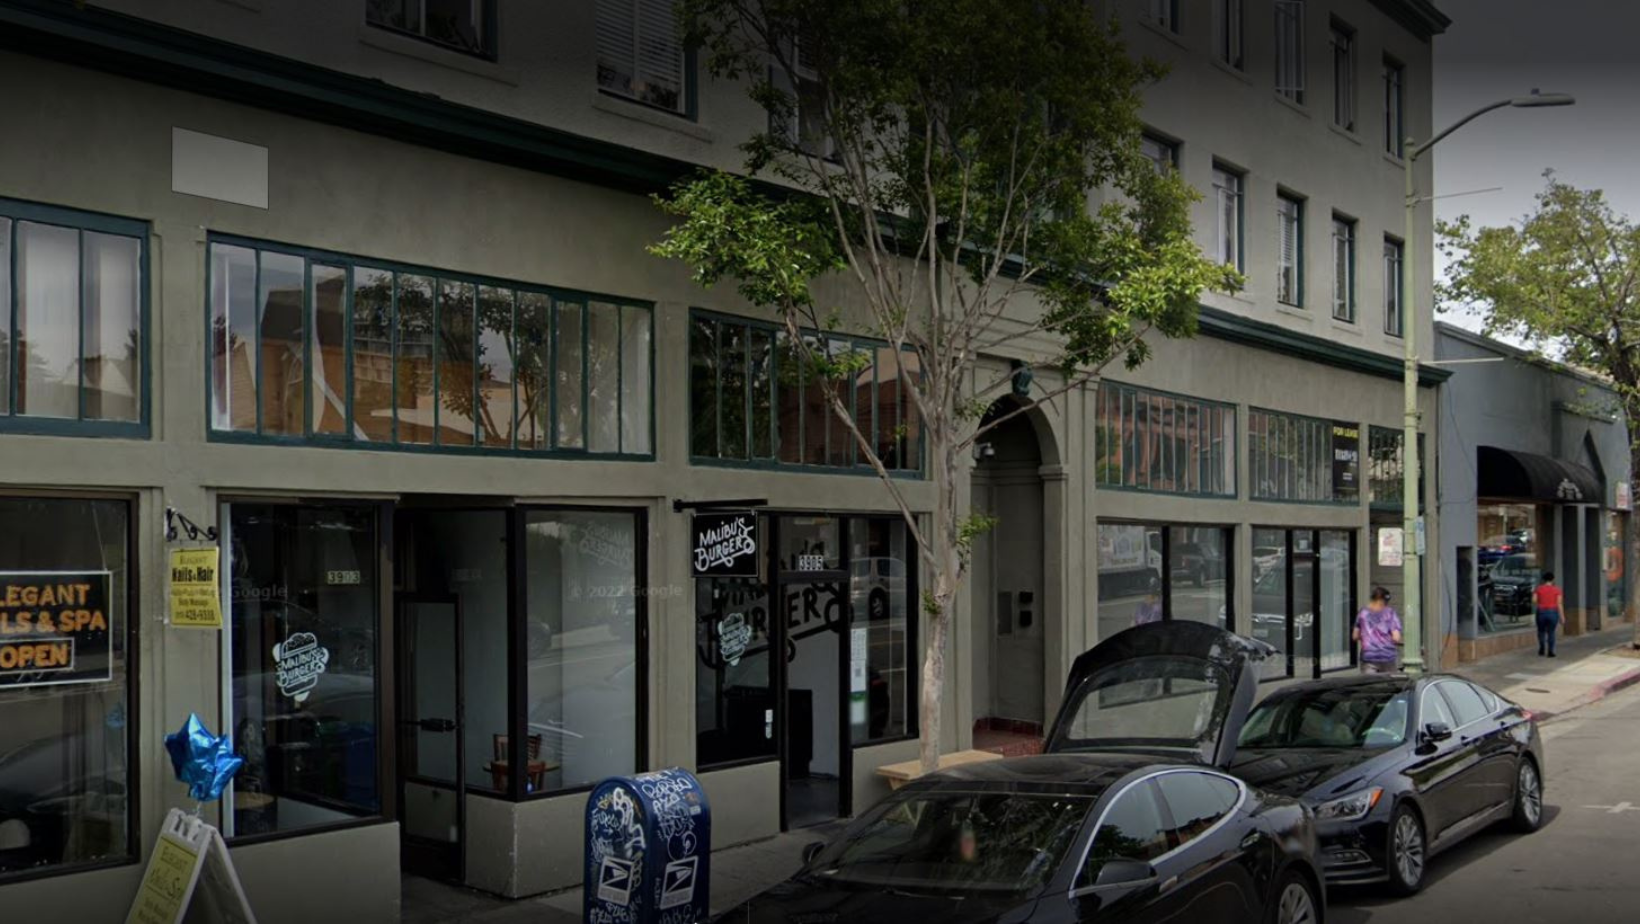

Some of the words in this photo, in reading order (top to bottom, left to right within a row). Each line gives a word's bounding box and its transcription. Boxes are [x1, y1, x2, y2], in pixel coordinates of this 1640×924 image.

[800, 556, 823, 570] 3905
[36, 611, 57, 633] &
[59, 610, 107, 632] SPA
[0, 643, 68, 668] OPEN
